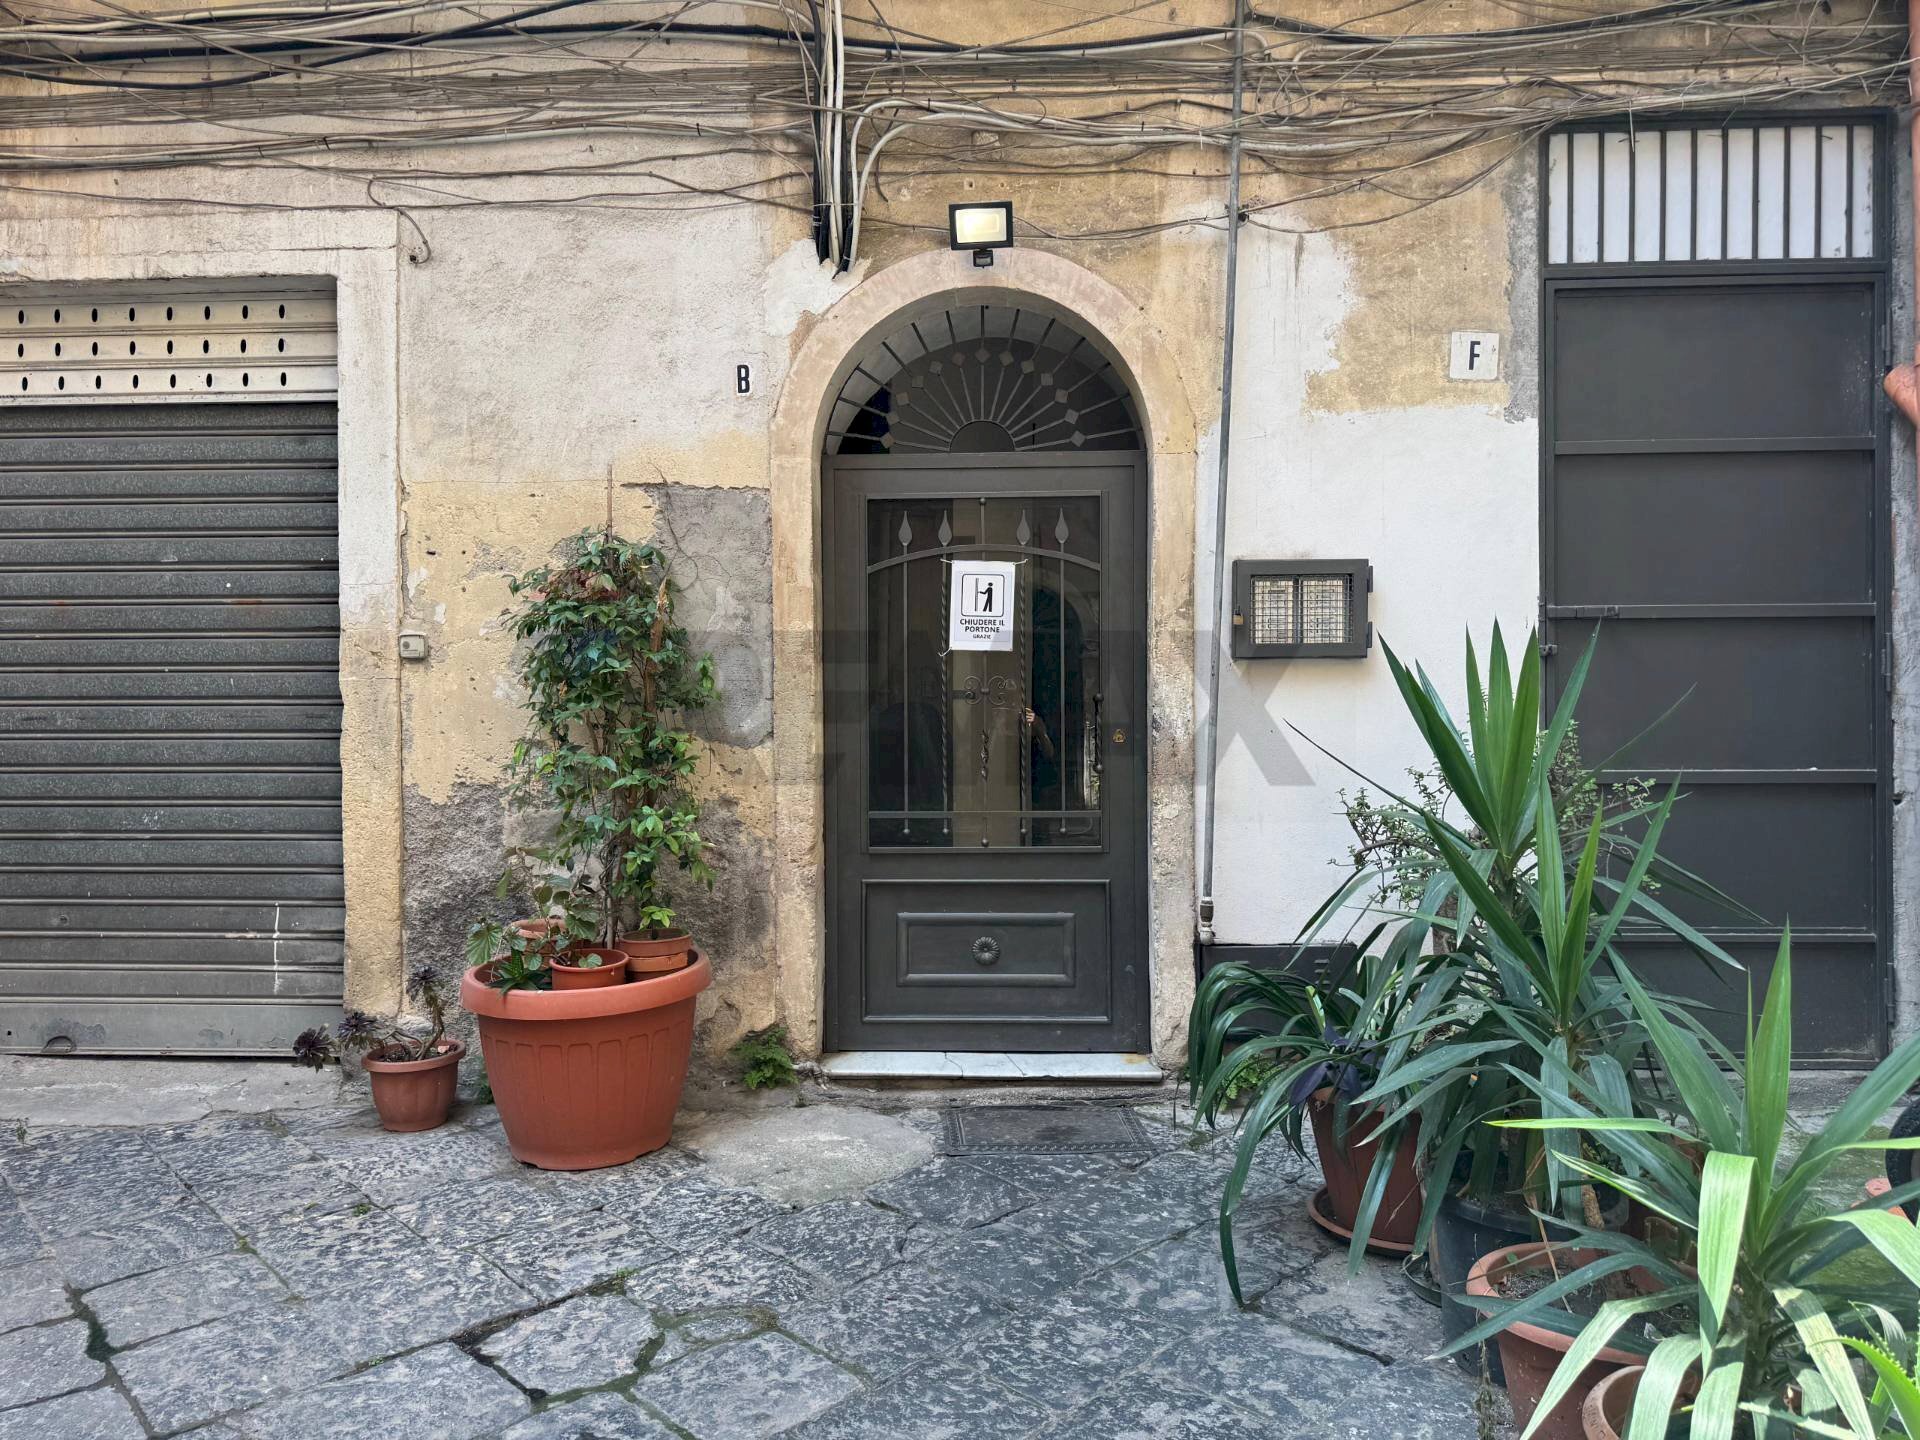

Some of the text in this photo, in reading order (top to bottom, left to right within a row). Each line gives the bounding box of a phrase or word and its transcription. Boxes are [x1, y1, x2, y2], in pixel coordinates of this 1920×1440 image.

[1468, 340, 1481, 371] F
[736, 364, 750, 394] B
[959, 618, 996, 626] CHIUDERE
